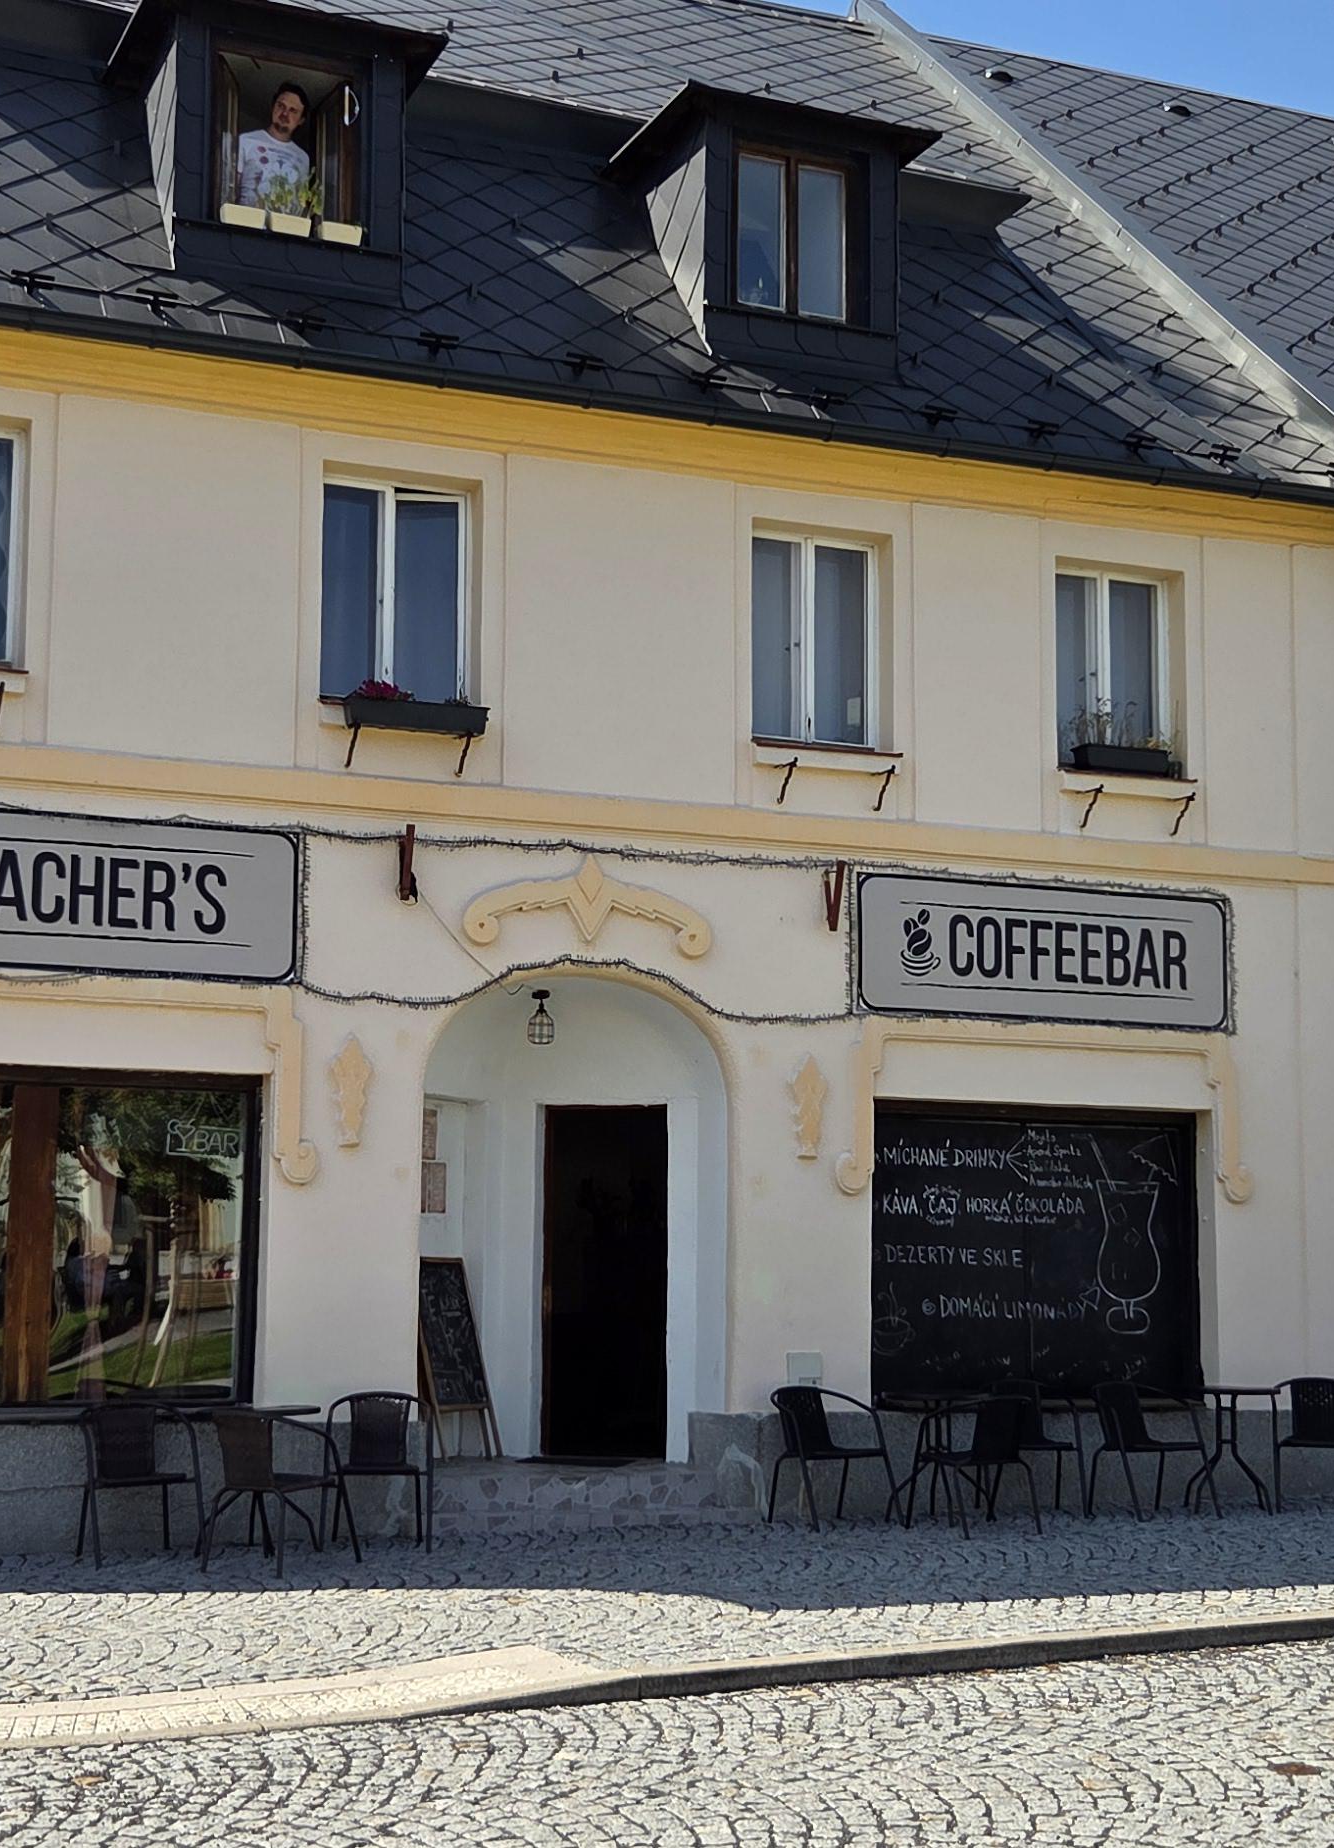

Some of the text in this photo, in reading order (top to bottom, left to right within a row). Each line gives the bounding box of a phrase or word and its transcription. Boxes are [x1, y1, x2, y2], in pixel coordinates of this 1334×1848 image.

[948, 914, 1188, 991] COFFEEBAR
[194, 1129, 237, 1154] BAR
[883, 1138, 950, 1168] MÍCHANÉ
[952, 1147, 1006, 1170] DRINKY
[882, 1187, 923, 1217] KÁVA,
[966, 1191, 1013, 1215] HORKÁ
[1015, 1191, 1086, 1215] ČOKOLÁDA
[883, 1243, 955, 1265] DEZERTY
[957, 1247, 978, 1266] VE
[939, 1291, 999, 1319] DOMÁCÍ
